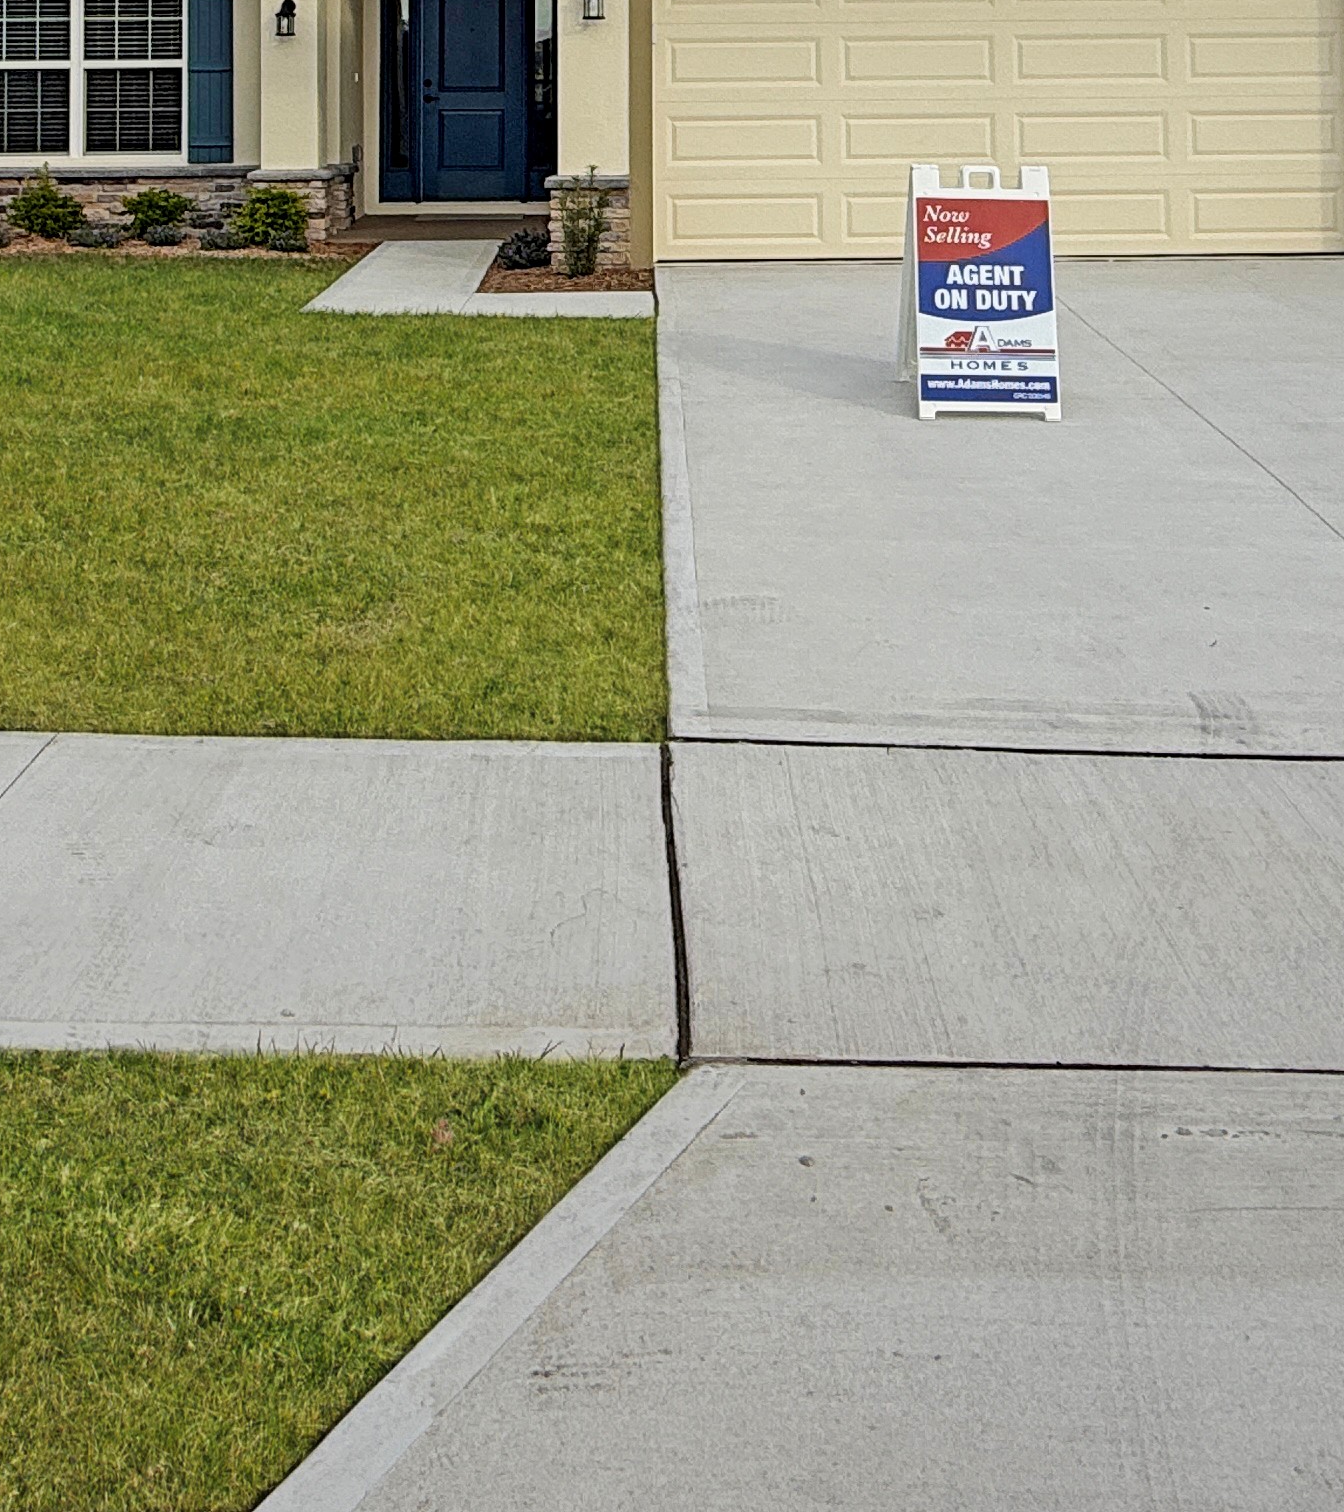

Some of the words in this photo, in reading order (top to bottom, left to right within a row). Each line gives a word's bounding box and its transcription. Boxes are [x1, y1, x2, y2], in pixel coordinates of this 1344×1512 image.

[923, 205, 970, 222] Now
[924, 226, 993, 249] Selling
[946, 265, 1024, 285] AGENT
[934, 289, 968, 310] ON
[976, 290, 1037, 311] DUTY
[967, 326, 1032, 352] ADAMS
[950, 360, 1029, 371] HOMES
